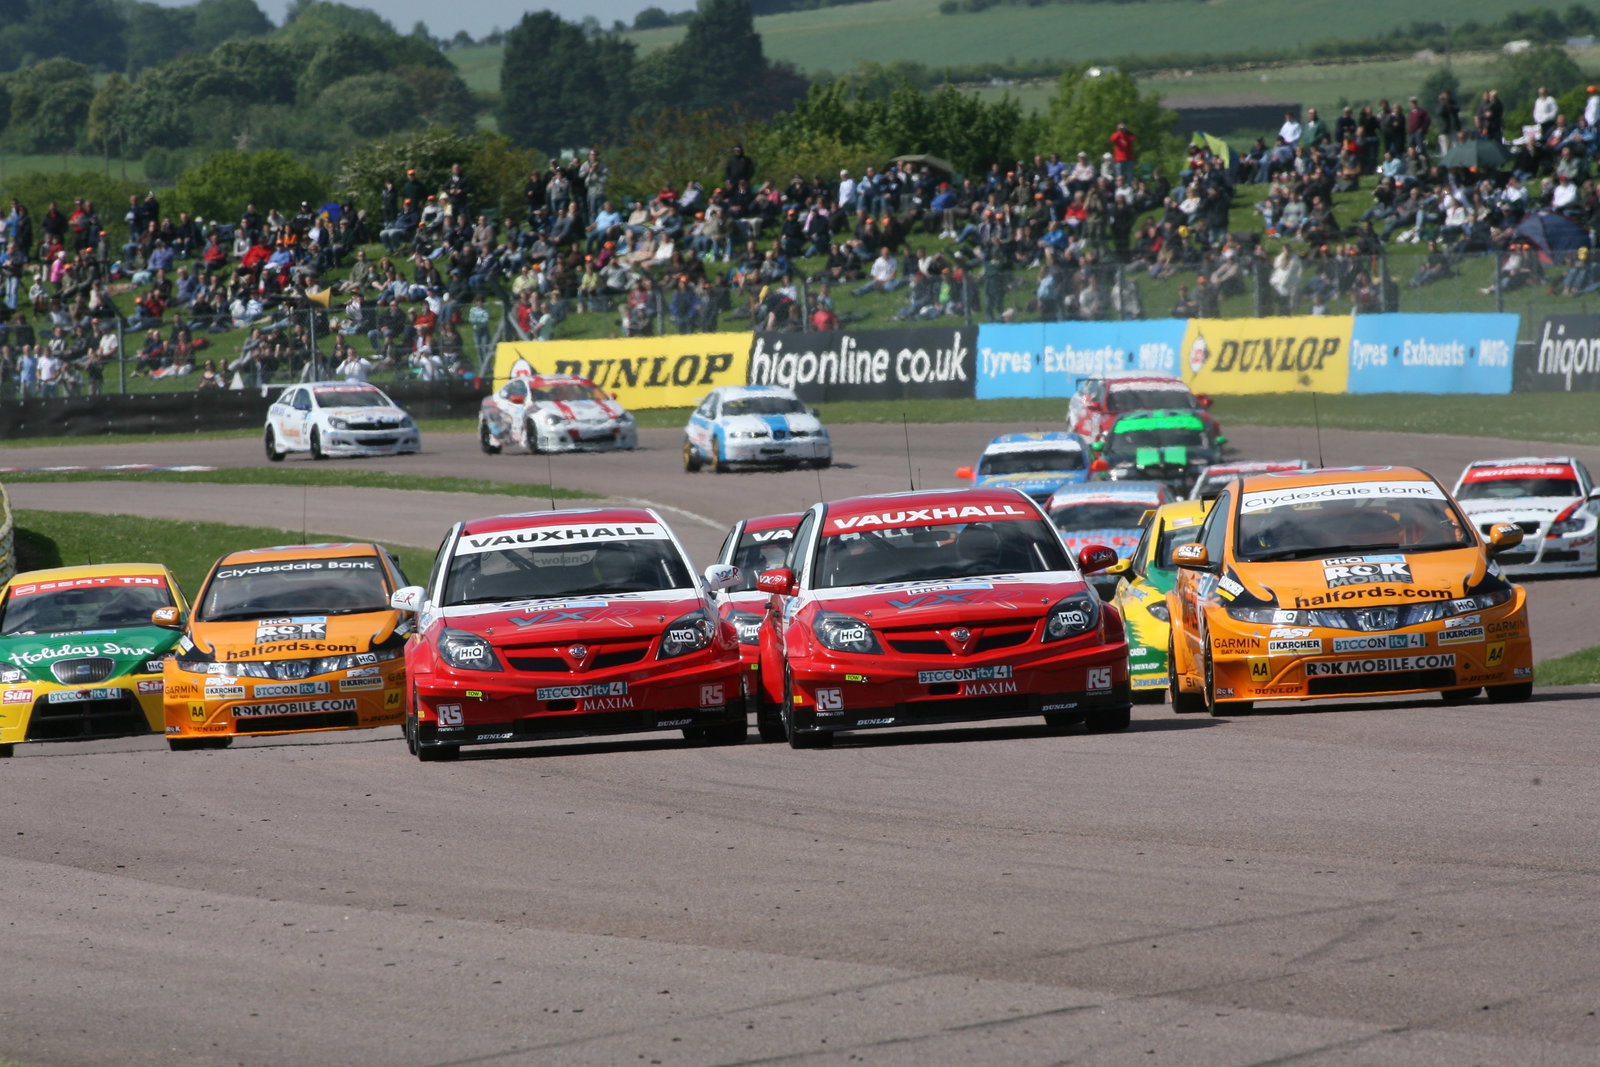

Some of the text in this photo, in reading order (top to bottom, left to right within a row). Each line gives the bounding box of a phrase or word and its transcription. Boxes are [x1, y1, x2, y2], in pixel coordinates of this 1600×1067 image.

[982, 347, 1032, 378] Tyres
[1044, 344, 1125, 374] Exhausts
[1212, 337, 1341, 373] DUNLOP
[1353, 339, 1388, 370] Tyres
[1402, 338, 1465, 366] Exhausts
[553, 353, 734, 389] DUNLOP
[1245, 486, 1434, 508] Clydesdale Bank
[834, 505, 1025, 529] VAUXHALL
[470, 527, 655, 548] VAUXHALL
[1326, 557, 1363, 566] HiQ
[217, 561, 375, 578] Clydesdale Bank
[1325, 563, 1410, 581] ROK
[39, 577, 159, 590] SEAT TDI
[1329, 575, 1413, 589] MOBILE
[887, 589, 1024, 610] VXR
[1295, 587, 1453, 609] halfords.com
[1455, 600, 1475, 610] HiQ
[508, 607, 641, 629] VXR
[1061, 613, 1082, 623] HiQ
[257, 624, 325, 638] ROK
[671, 632, 694, 642] HiQ
[842, 629, 863, 640] HiQ
[1270, 628, 1313, 638] FAST
[257, 633, 325, 644] MOBILE
[1214, 638, 1259, 648] GARMIN
[9, 643, 154, 665] Holiday Inn
[227, 642, 357, 660] halfords.com
[461, 647, 482, 657] HiQ
[1488, 648, 1503, 661] AA
[358, 655, 375, 663] HiQ
[1252, 663, 1267, 676] AA
[1088, 668, 1111, 689] RS
[165, 685, 198, 694] GARMIN
[702, 684, 724, 704] RS
[965, 682, 1017, 695] MAXIM
[584, 697, 634, 711] MAXIM
[817, 690, 842, 709] RS
[1042, 702, 1078, 710] DUNLOP
[192, 706, 204, 717] AA
[439, 705, 462, 725] RS
[657, 719, 692, 727] DUNLOP
